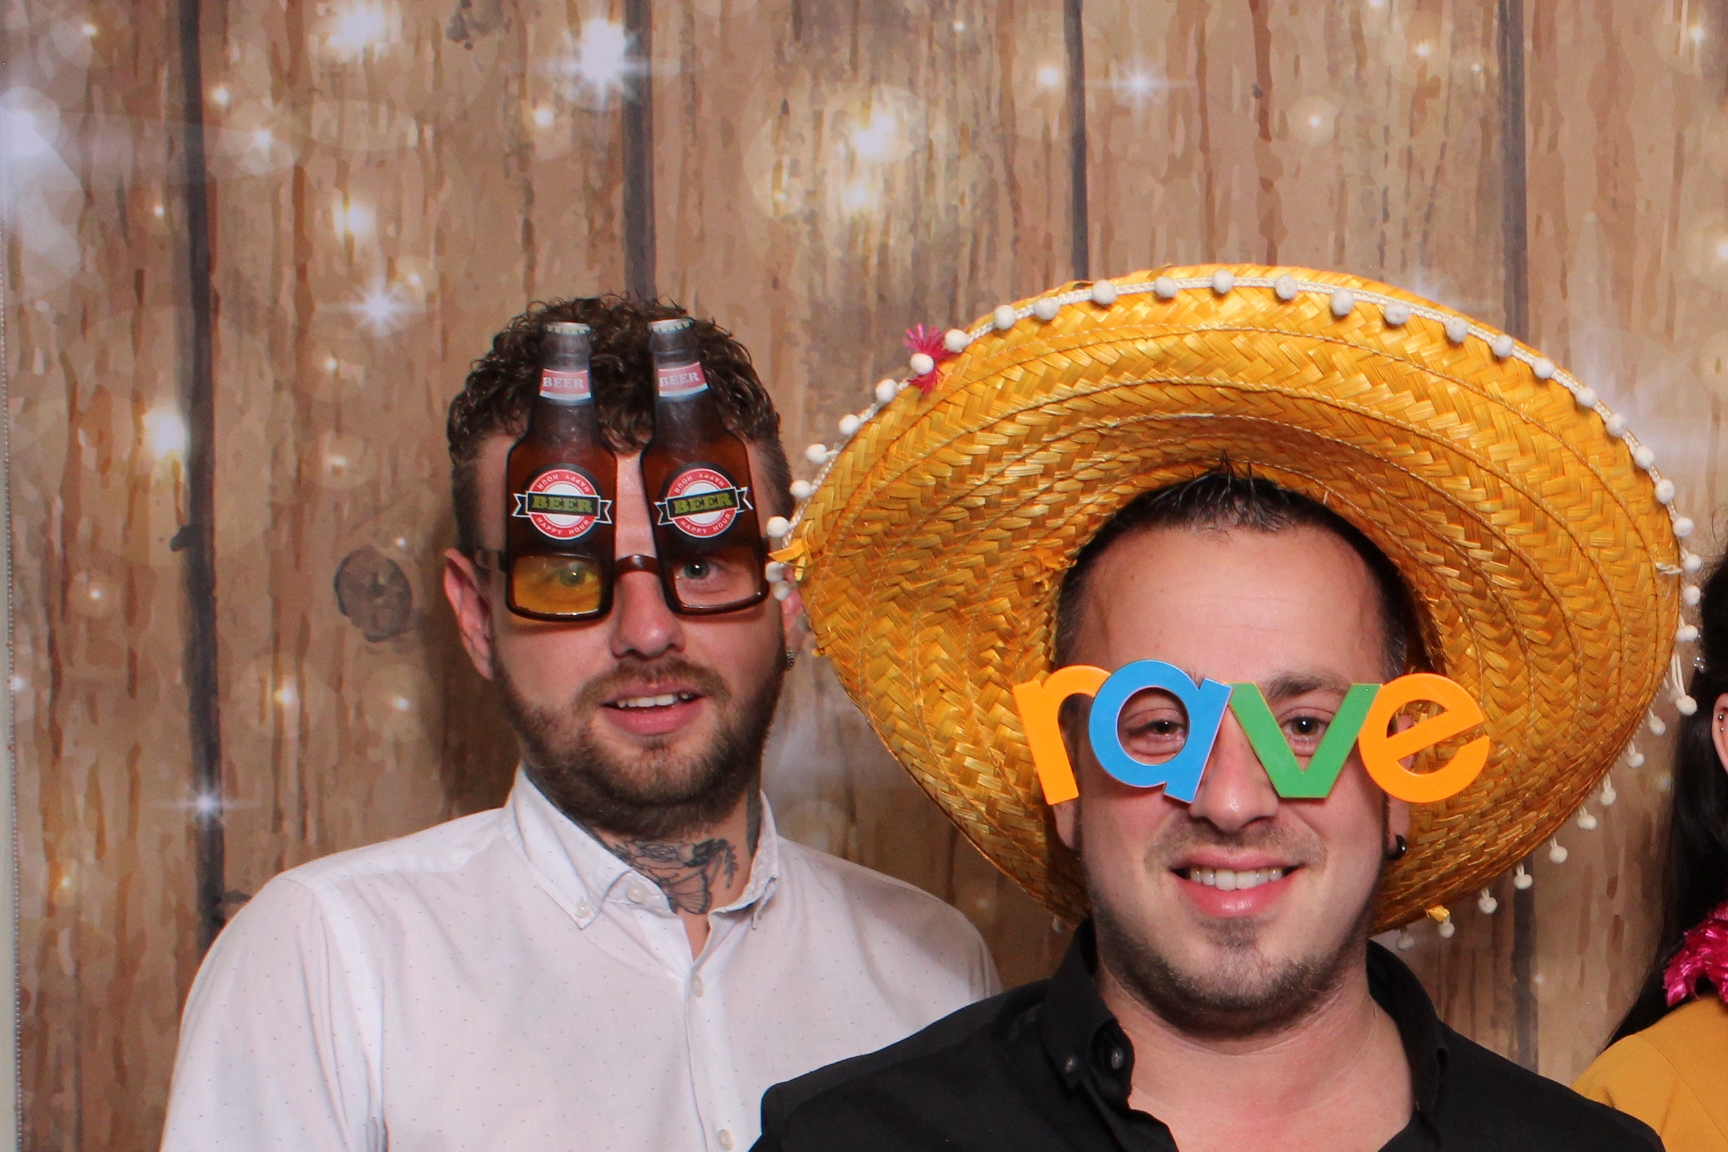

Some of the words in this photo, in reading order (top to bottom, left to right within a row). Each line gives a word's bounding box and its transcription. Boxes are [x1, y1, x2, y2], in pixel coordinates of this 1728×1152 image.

[542, 376, 584, 389] BEER
[659, 372, 700, 387] BEER
[531, 495, 593, 513] BEER
[673, 492, 734, 515] BEER
[536, 517, 563, 535] HAPPY
[568, 519, 590, 534] HOUR
[680, 520, 708, 534] HAPPY
[713, 512, 732, 532] HOUR
[1011, 659, 1490, 806] rave
